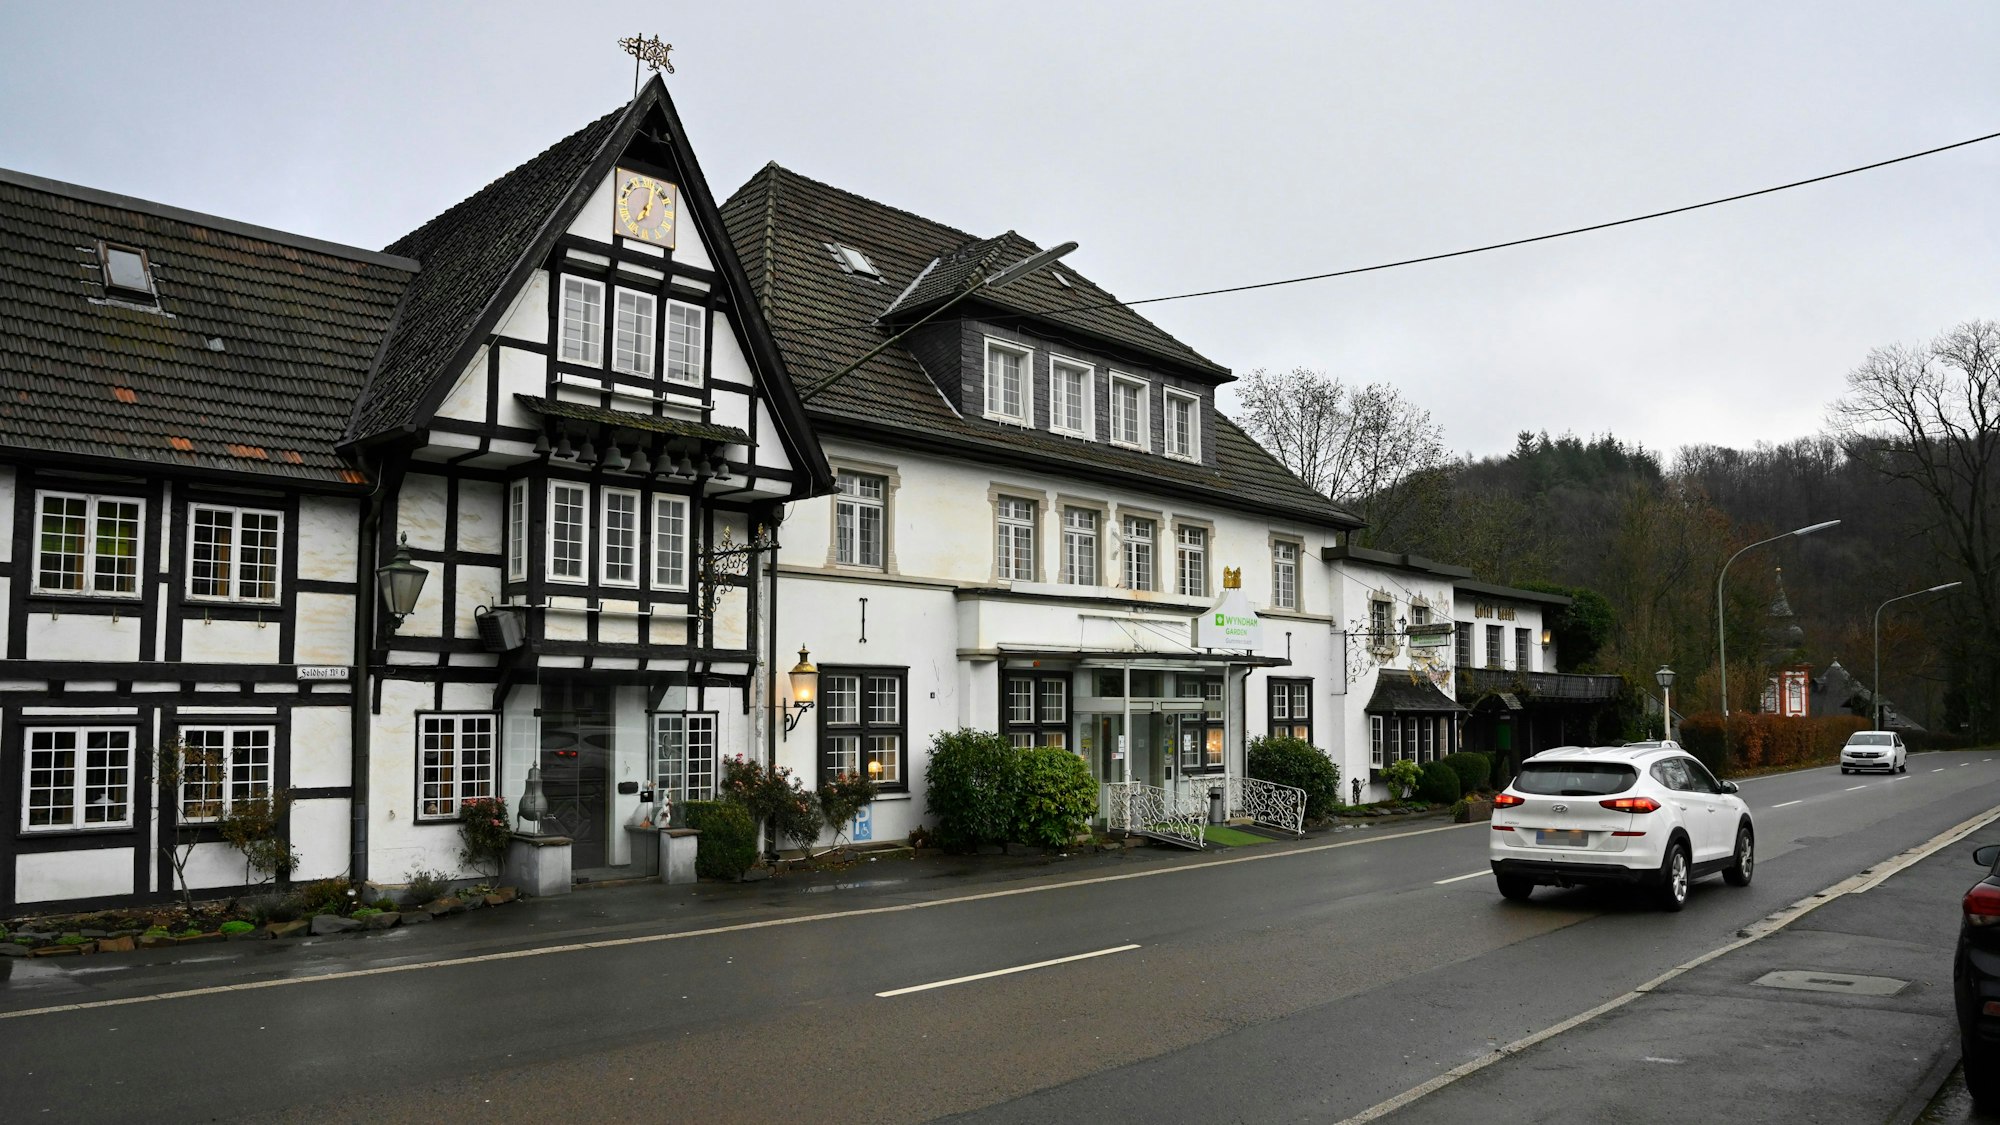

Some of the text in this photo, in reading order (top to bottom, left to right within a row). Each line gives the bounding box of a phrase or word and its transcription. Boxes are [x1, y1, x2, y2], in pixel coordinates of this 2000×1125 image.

[1226, 616, 1258, 627] WYNDHAM
[1226, 627, 1248, 636] GARDEN
[340, 669, 346, 677] 6
[855, 805, 870, 835] P
